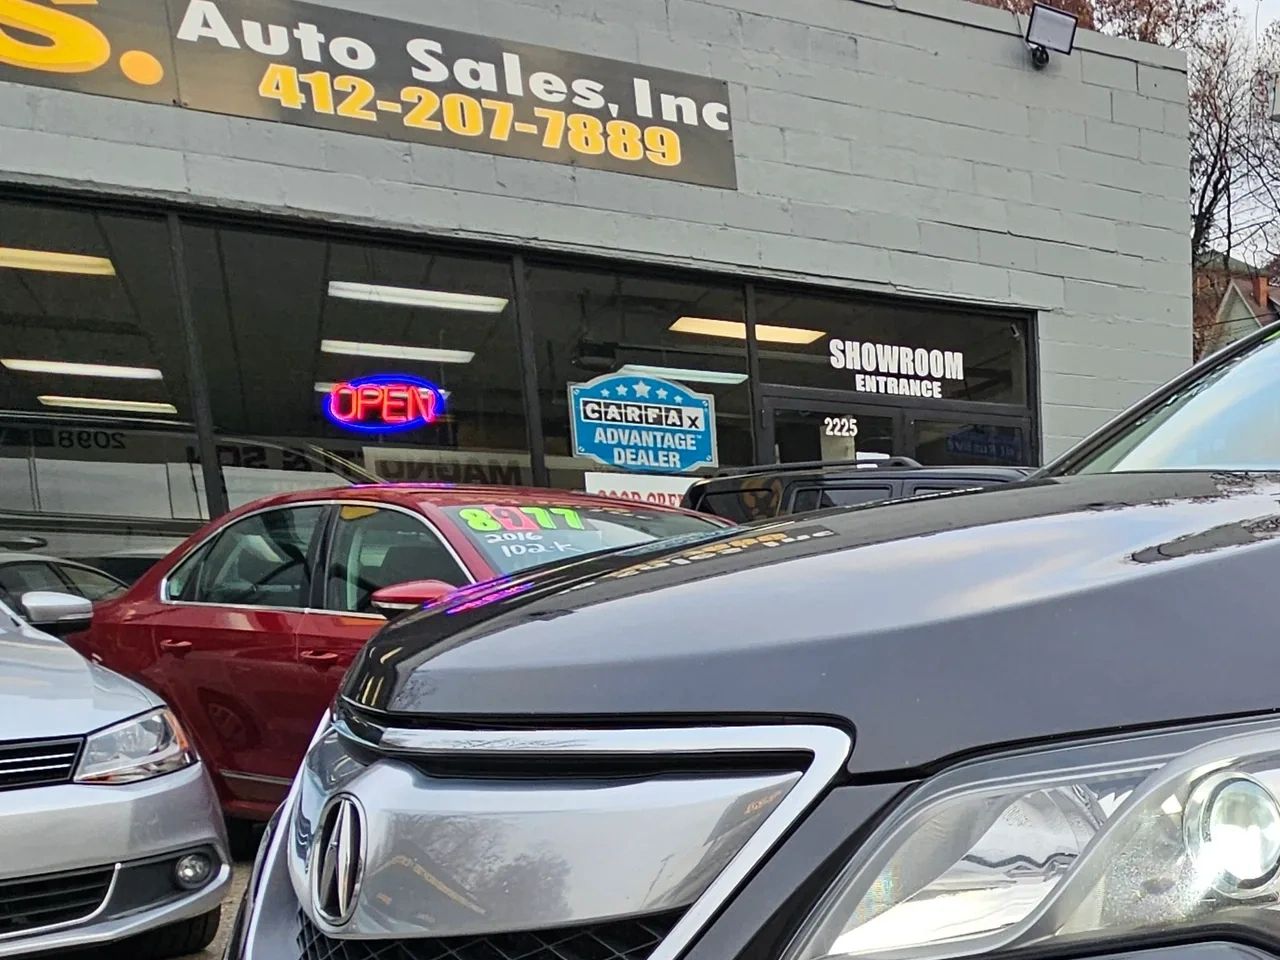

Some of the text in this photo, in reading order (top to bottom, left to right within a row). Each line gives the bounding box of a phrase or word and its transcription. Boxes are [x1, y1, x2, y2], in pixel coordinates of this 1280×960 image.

[177, 0, 376, 70] Auto
[406, 37, 619, 118] Sales,
[633, 77, 731, 131] Inc
[258, 62, 682, 167] 412-207-7889
[829, 339, 964, 380] SHOWROOM
[855, 373, 942, 398] ENTRANCE
[331, 383, 435, 423] OPEN
[584, 402, 700, 429] CARFAX
[824, 417, 858, 437] 2225
[613, 447, 681, 468] DEALER
[458, 507, 585, 532] 8977
[485, 532, 543, 544] 2016
